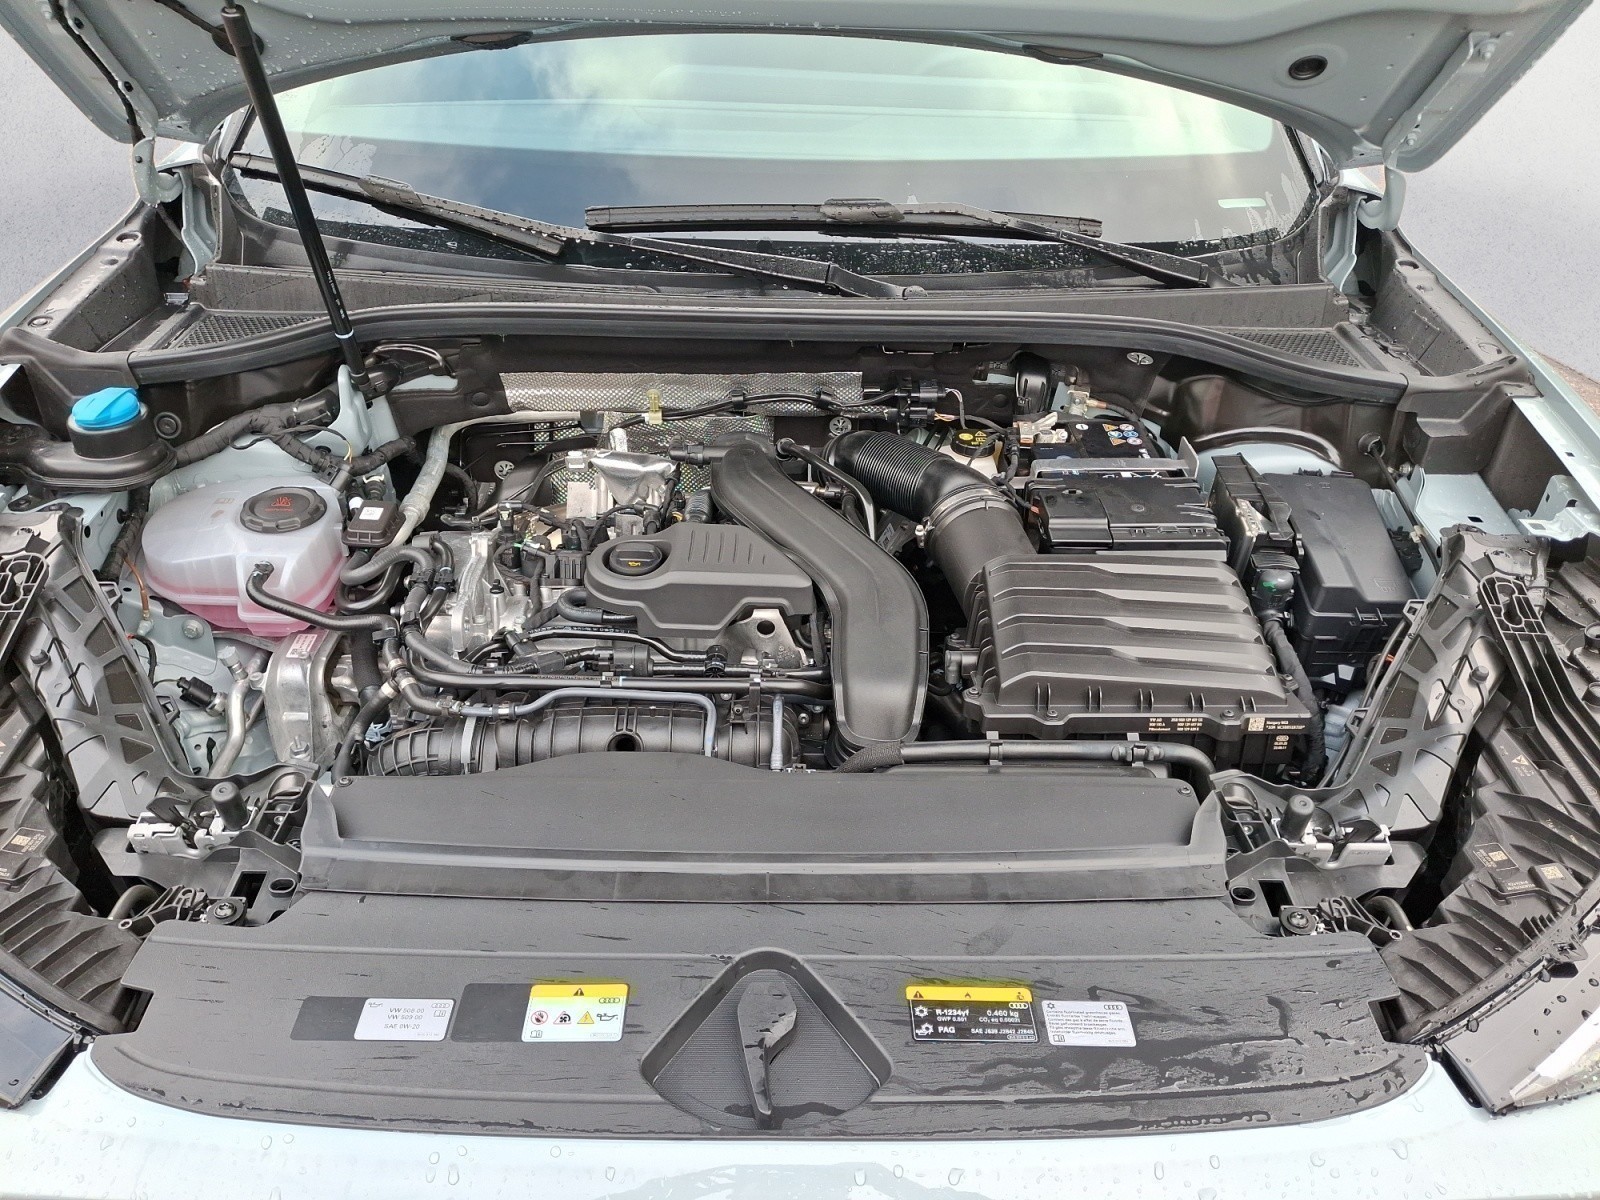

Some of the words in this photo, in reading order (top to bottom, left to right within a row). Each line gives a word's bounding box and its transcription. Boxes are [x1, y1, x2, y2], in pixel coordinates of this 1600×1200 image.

[935, 1009, 970, 1017] R-1234yf
[1009, 1009, 1019, 1018] kg
[938, 1026, 955, 1034] PAG
